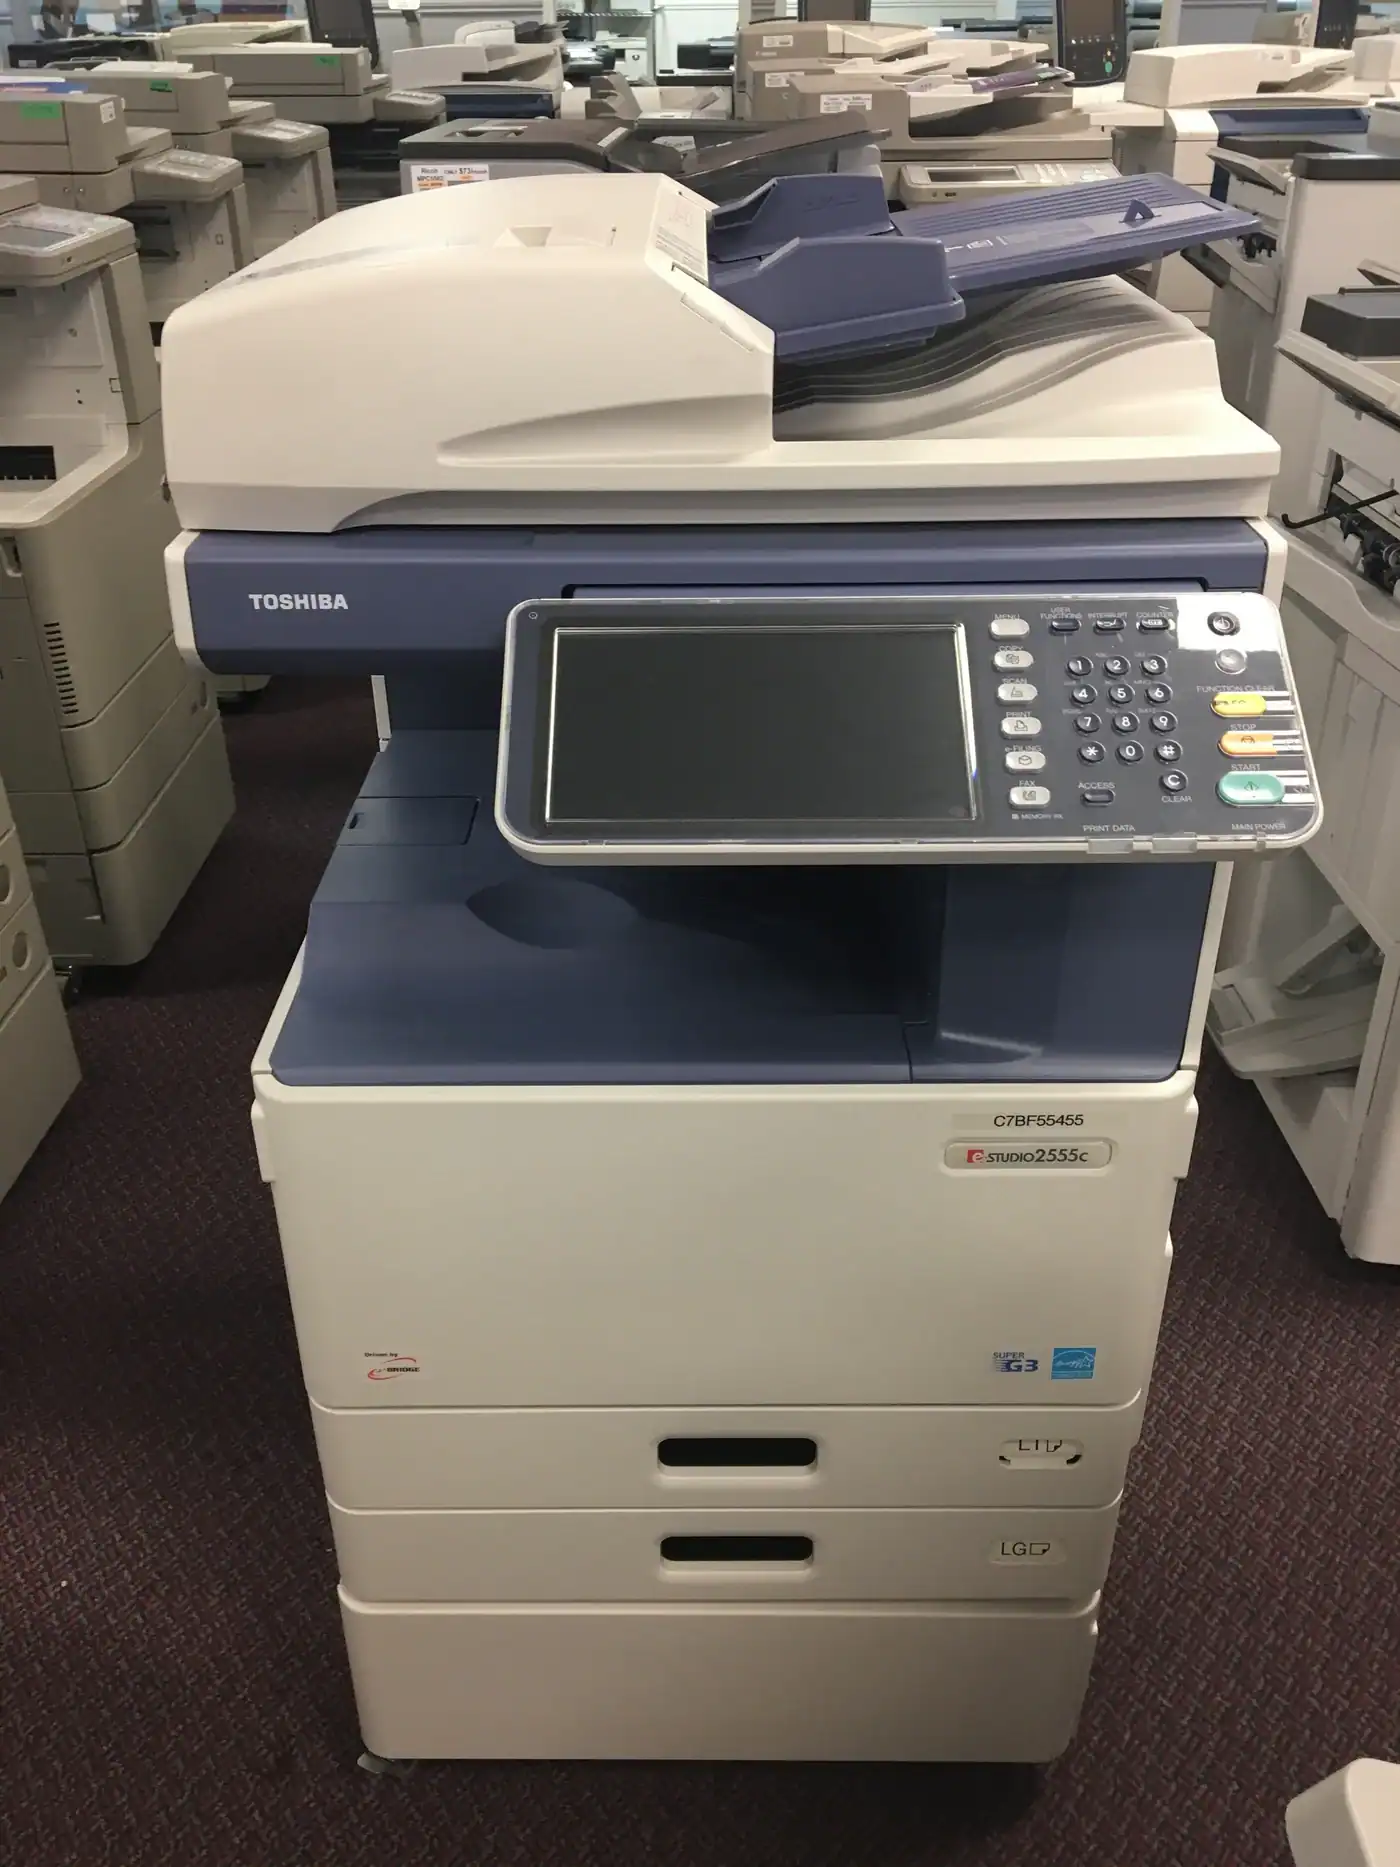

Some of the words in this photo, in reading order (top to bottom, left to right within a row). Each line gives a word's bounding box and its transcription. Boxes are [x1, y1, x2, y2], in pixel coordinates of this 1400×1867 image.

[248, 593, 349, 610] TOSHIBA
[1076, 660, 1083, 671] 1
[1113, 659, 1122, 670] 2
[1150, 659, 1159, 670] 3
[1078, 688, 1088, 698] 4
[1117, 688, 1126, 698] 5
[1155, 688, 1164, 698] 6
[1196, 685, 1243, 693] FUNCTION
[1084, 716, 1092, 727] 7
[1121, 717, 1131, 727] 8
[1159, 716, 1168, 726] 9
[1230, 723, 1256, 731] STOP
[1125, 746, 1135, 757] 0
[1231, 763, 1261, 771] START
[1167, 774, 1181, 785] C
[1078, 781, 1116, 789] ACCESS
[1161, 795, 1193, 803] CLEAR
[1082, 824, 1110, 832] PRINT
[1112, 824, 1136, 832] DATA
[1231, 823, 1253, 831] MAIN
[1254, 822, 1286, 830] POWER
[993, 1114, 1084, 1127] C7BF55455
[992, 1351, 1025, 1359] SUPER
[1001, 1541, 1027, 1556] LG
